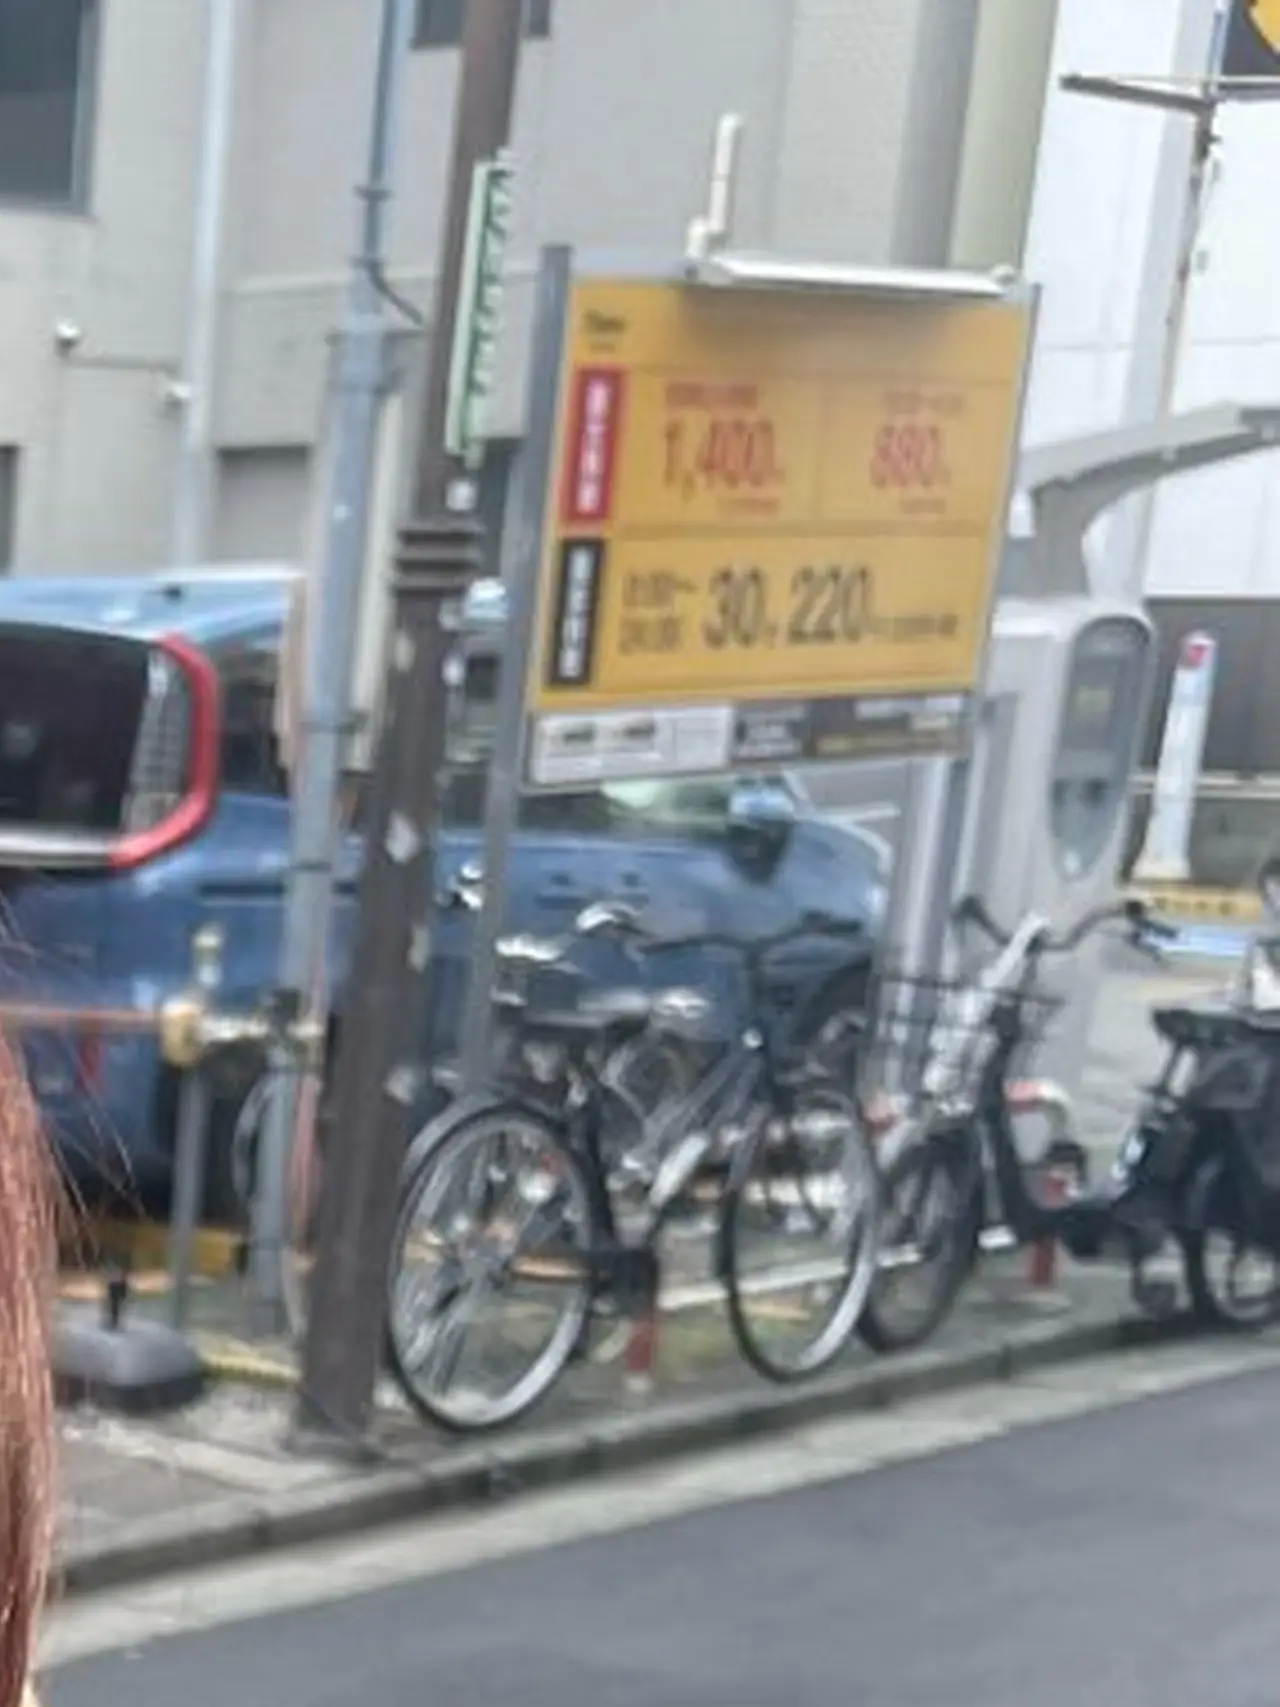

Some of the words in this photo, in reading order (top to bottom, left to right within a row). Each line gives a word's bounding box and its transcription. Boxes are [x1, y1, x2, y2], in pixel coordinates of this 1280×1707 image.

[662, 419, 776, 501] 1,400
[704, 564, 767, 650] 30
[789, 563, 872, 645] 220
